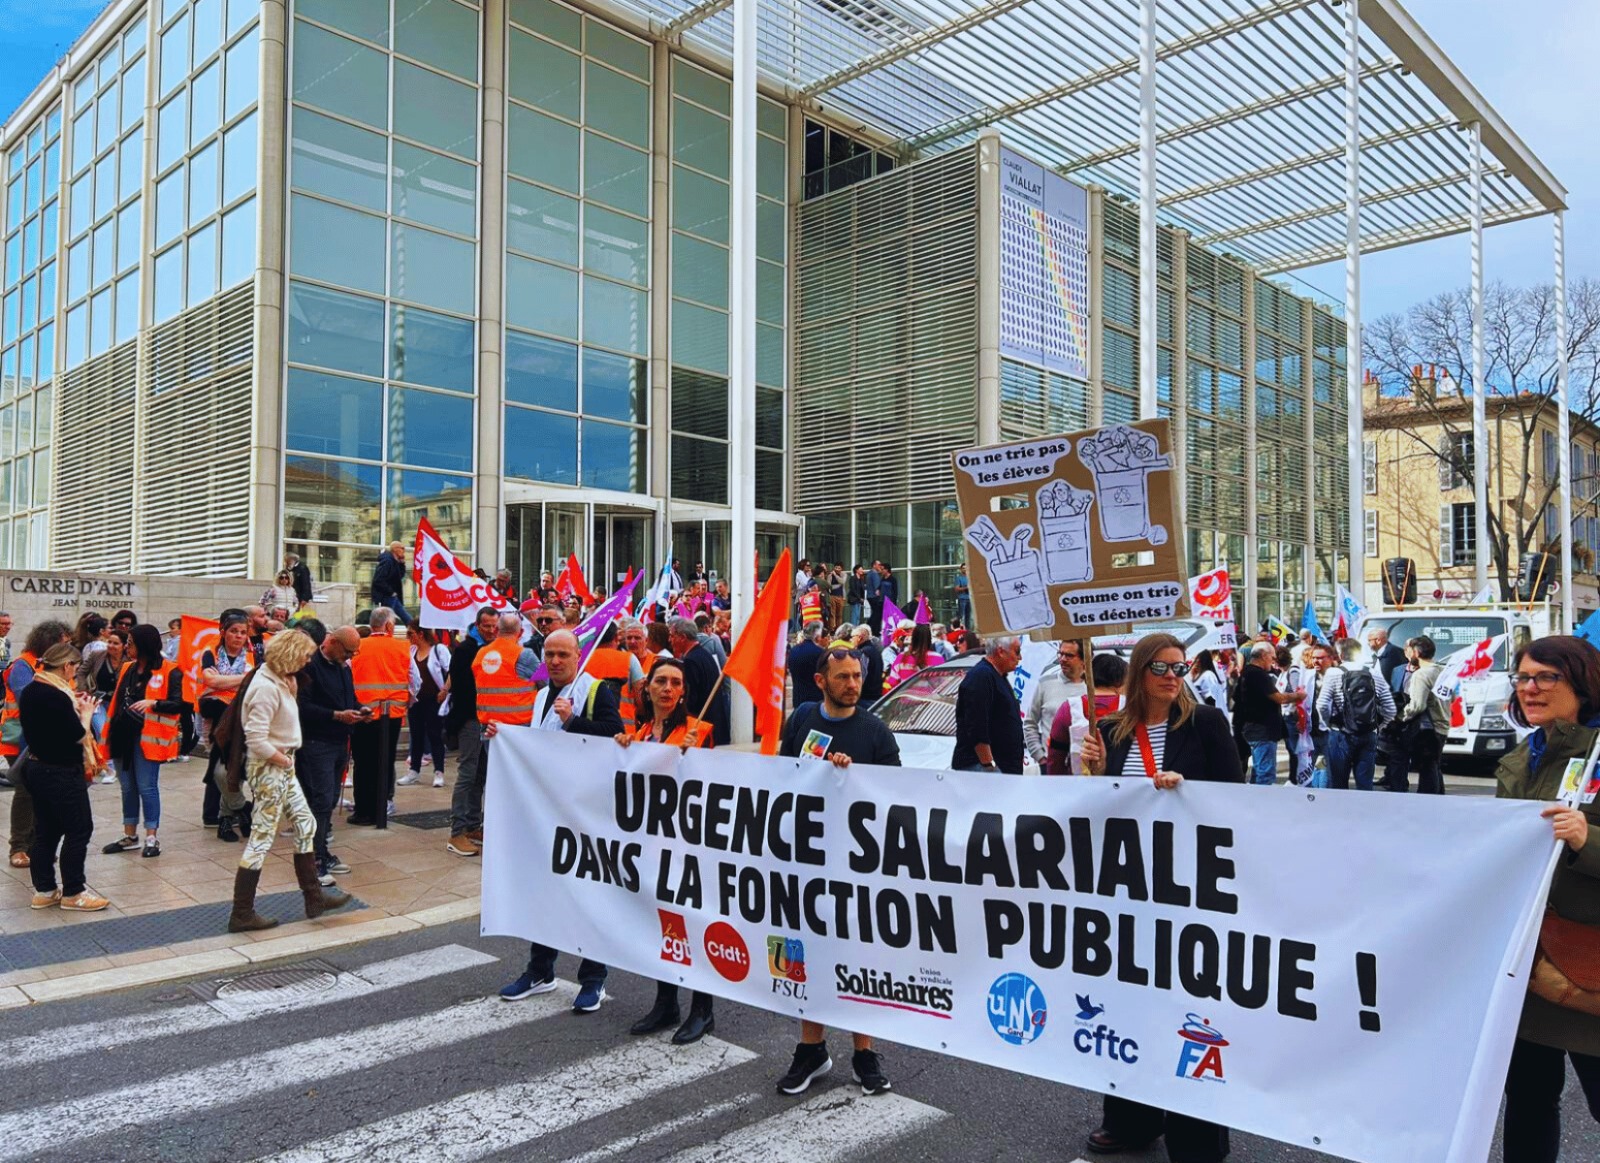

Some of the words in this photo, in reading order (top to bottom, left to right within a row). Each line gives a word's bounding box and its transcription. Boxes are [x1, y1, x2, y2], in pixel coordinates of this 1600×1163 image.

[1003, 158, 1022, 173] CLAUDE
[1009, 172, 1042, 196] VIALLAT
[959, 456, 980, 467] On
[984, 453, 1002, 463] ne
[1006, 446, 1035, 460] trie
[1039, 443, 1065, 459] pas
[978, 472, 999, 483] les
[1002, 464, 1050, 480] élèves
[10, 577, 75, 594] CARRE
[80, 580, 135, 596] D'ART
[470, 584, 507, 609] cg
[1062, 591, 1119, 606] comme
[1123, 590, 1143, 600] on
[1147, 586, 1179, 599] trie
[52, 599, 78, 607] JEAN
[85, 600, 134, 609] BOUSQUET
[1073, 612, 1095, 624] les
[1099, 606, 1161, 622] déchets
[1165, 605, 1171, 616] !
[615, 770, 826, 867] URGENCE
[848, 800, 1238, 914] SALARIALE
[552, 826, 642, 893] DANS
[656, 848, 702, 910] LA
[718, 861, 957, 954] FONCTION
[983, 898, 1317, 1021] PUBLIQUE
[1355, 951, 1381, 1032] !
[662, 935, 692, 961] cgt
[919, 967, 941, 976] Union
[920, 976, 952, 986] syndicale
[835, 963, 953, 1012] Solidaires
[1007, 1027, 1024, 1038] Gard
[1073, 1024, 1139, 1064] cftc
[1176, 1040, 1223, 1078] FA
